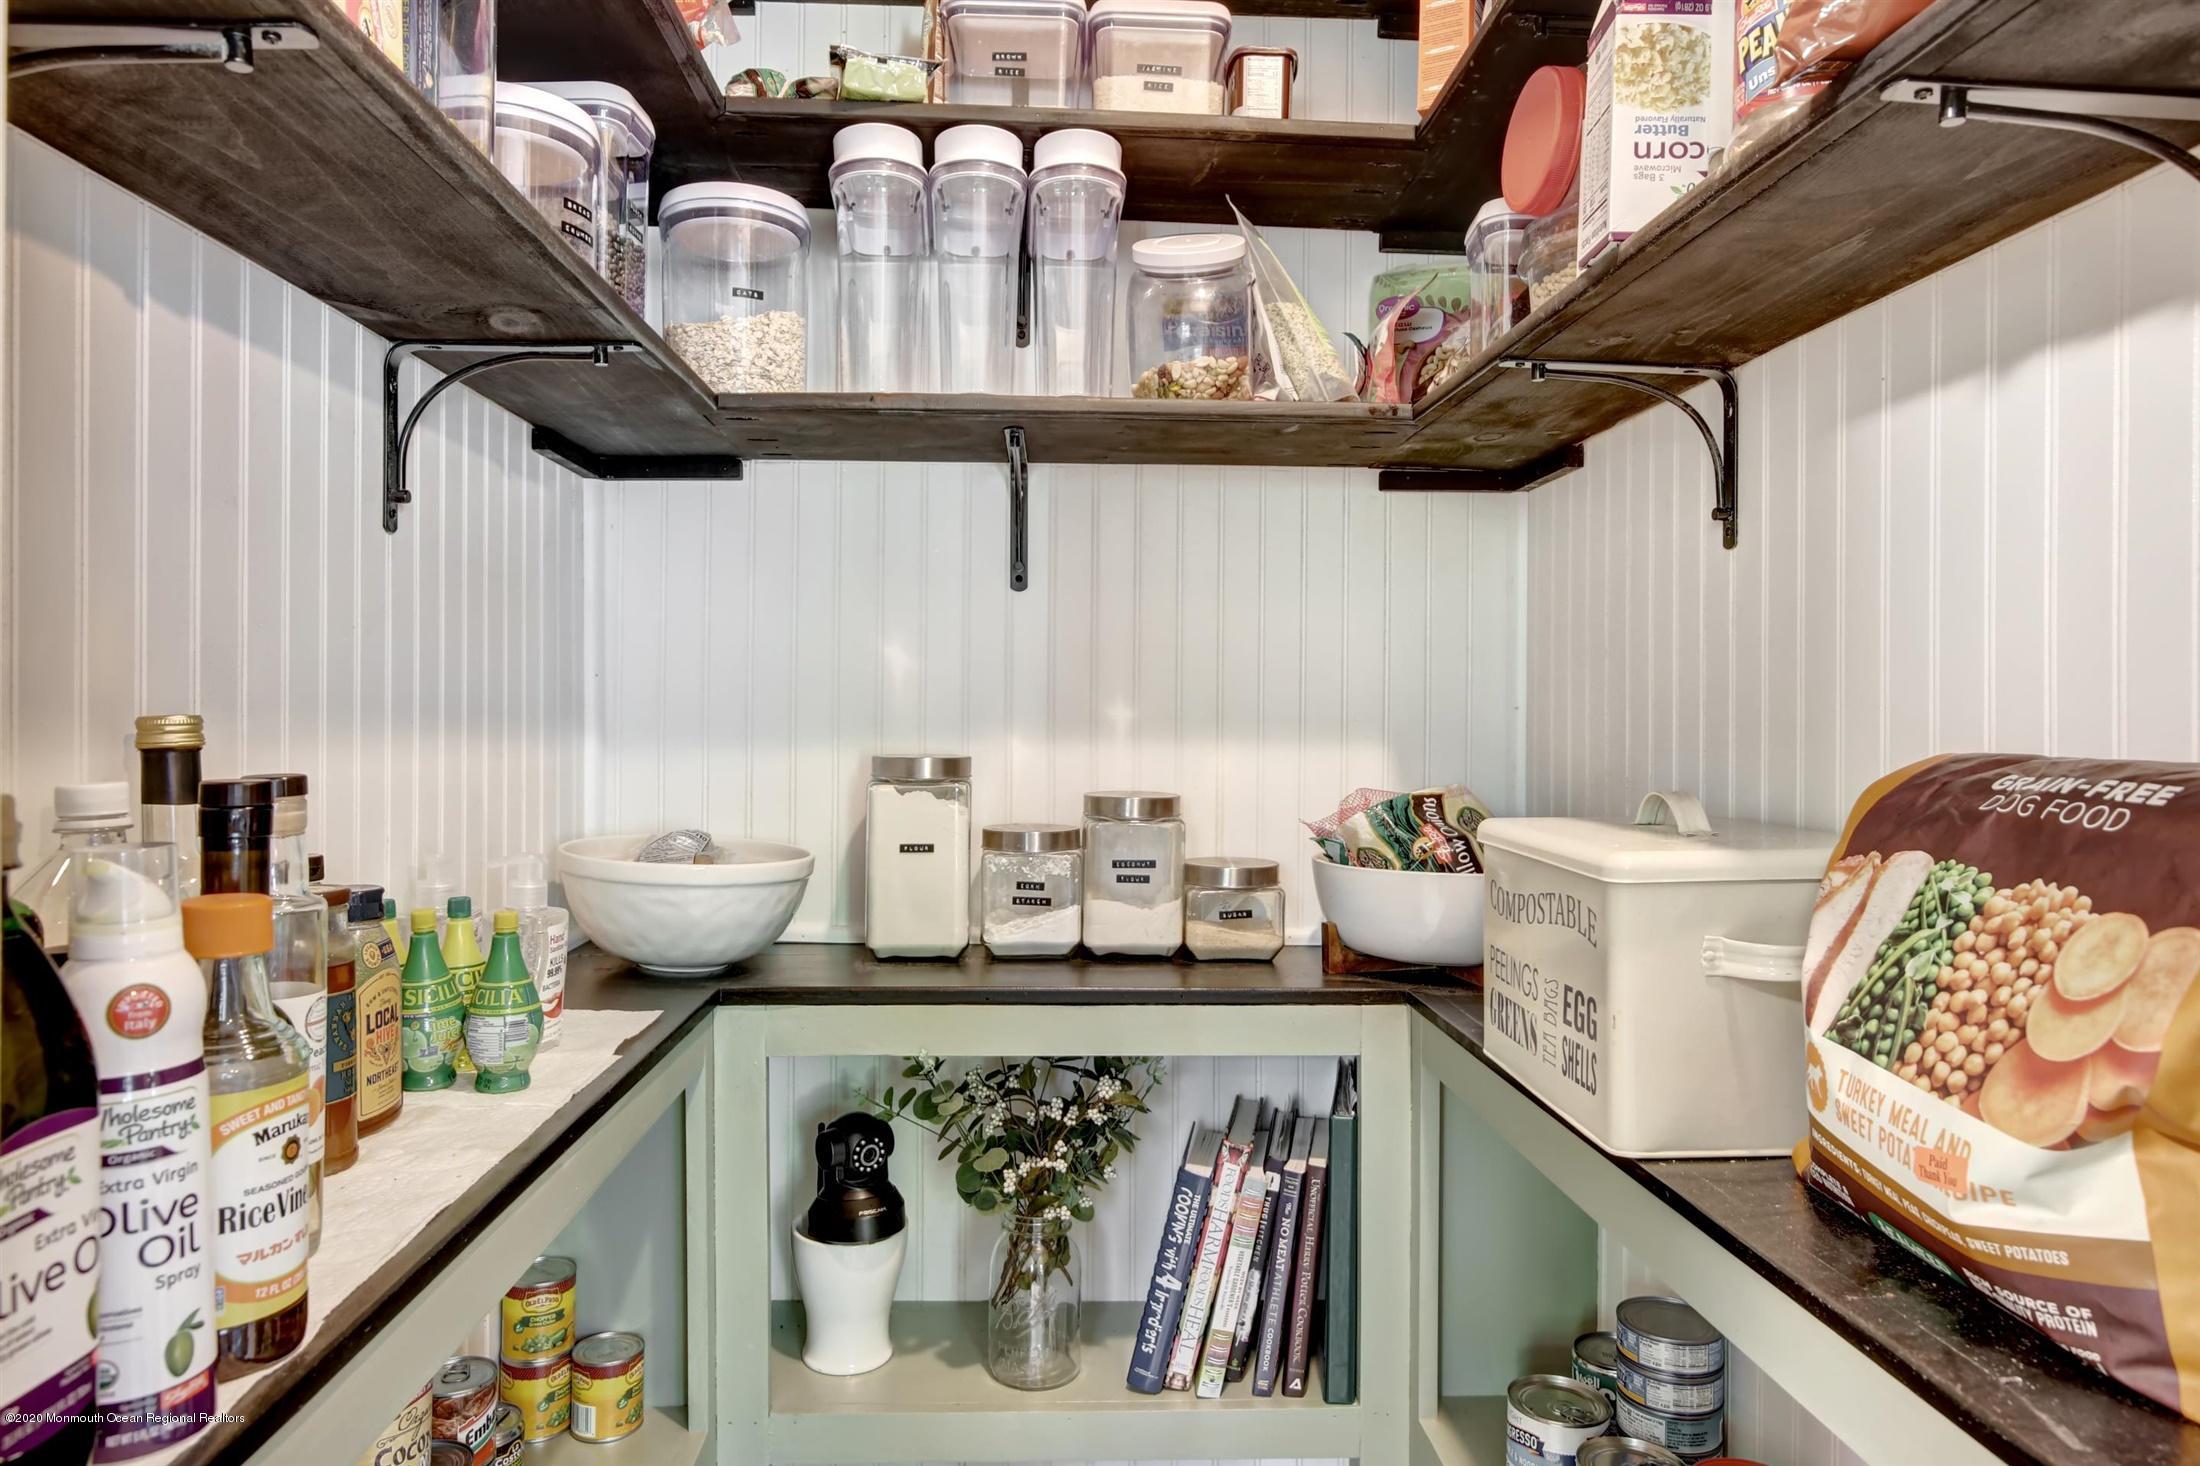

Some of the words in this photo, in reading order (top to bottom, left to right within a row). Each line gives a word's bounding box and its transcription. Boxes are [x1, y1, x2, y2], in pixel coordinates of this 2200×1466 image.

[998, 68, 1021, 76] RICE
[1634, 115, 1668, 123] Flavored
[1634, 125, 1689, 137] Butter
[1670, 116, 1706, 124] Naturally
[1633, 141, 1705, 159] corn
[1633, 165, 1682, 174] Microwave
[1633, 173, 1656, 182] Bags
[1658, 174, 1665, 182] 3
[735, 289, 760, 299] OATS
[1990, 775, 2185, 806] GRAIN-FREE
[1423, 796, 1459, 840] Onions
[2040, 799, 2131, 832] FOOD
[1490, 879, 1598, 949] COMPOSTABLE
[1490, 944, 1540, 1001] PEELINGS
[474, 988, 524, 1007] CILIA
[1543, 977, 1560, 1028] BAGS
[1562, 983, 1598, 1042] EGG
[366, 1005, 399, 1034] LOCAL
[1490, 986, 1538, 1057] GREENS
[375, 1027, 398, 1045] HIVE
[1542, 1031, 1558, 1068] TEA
[1561, 1035, 1598, 1096] SHELLS
[100, 1097, 196, 1131] holesome
[219, 1110, 261, 1136] SWEET
[263, 1096, 286, 1118] AND
[252, 1113, 309, 1147] Maruka
[1838, 1069, 1886, 1117] TURKEY
[1888, 1101, 1928, 1145] MEAL
[1933, 1128, 1972, 1161] AND
[118, 1119, 194, 1144] Pantry
[1835, 1098, 1874, 1142] SWEET
[1878, 1126, 1911, 1170] POTA
[152, 1161, 198, 1184] Virgin
[1919, 1164, 1941, 1183] Thank
[1928, 1154, 1948, 1170] Paid
[243, 1173, 294, 1197] SEASONED
[218, 1200, 275, 1236] Rice
[276, 1184, 309, 1218] Vine
[34, 1222, 77, 1252] Extra
[1184, 1209, 1199, 1244] ULTIMATE
[1201, 1207, 1228, 1268] HARM
[1280, 1217, 1291, 1236] NO
[138, 1221, 201, 1268] Oil
[1275, 1237, 1289, 1273] MEAT
[1302, 1234, 1315, 1267] HARRY
[1966, 1237, 2001, 1256] SWEET
[2005, 1246, 2070, 1266] POTATOES
[154, 1263, 201, 1291] Spray
[255, 1286, 268, 1299] 12
[1155, 1271, 1183, 1291] 4
[1268, 1273, 1283, 1326] ATHLETE
[1993, 1285, 2059, 1314] SOURCE
[2065, 1305, 2093, 1319] OF
[1178, 1302, 1205, 1354] HEAL
[1292, 1307, 1308, 1363] COOKBOOK
[2037, 1312, 2098, 1338] PROTEIN
[1262, 1328, 1275, 1371] COOKBOOK
